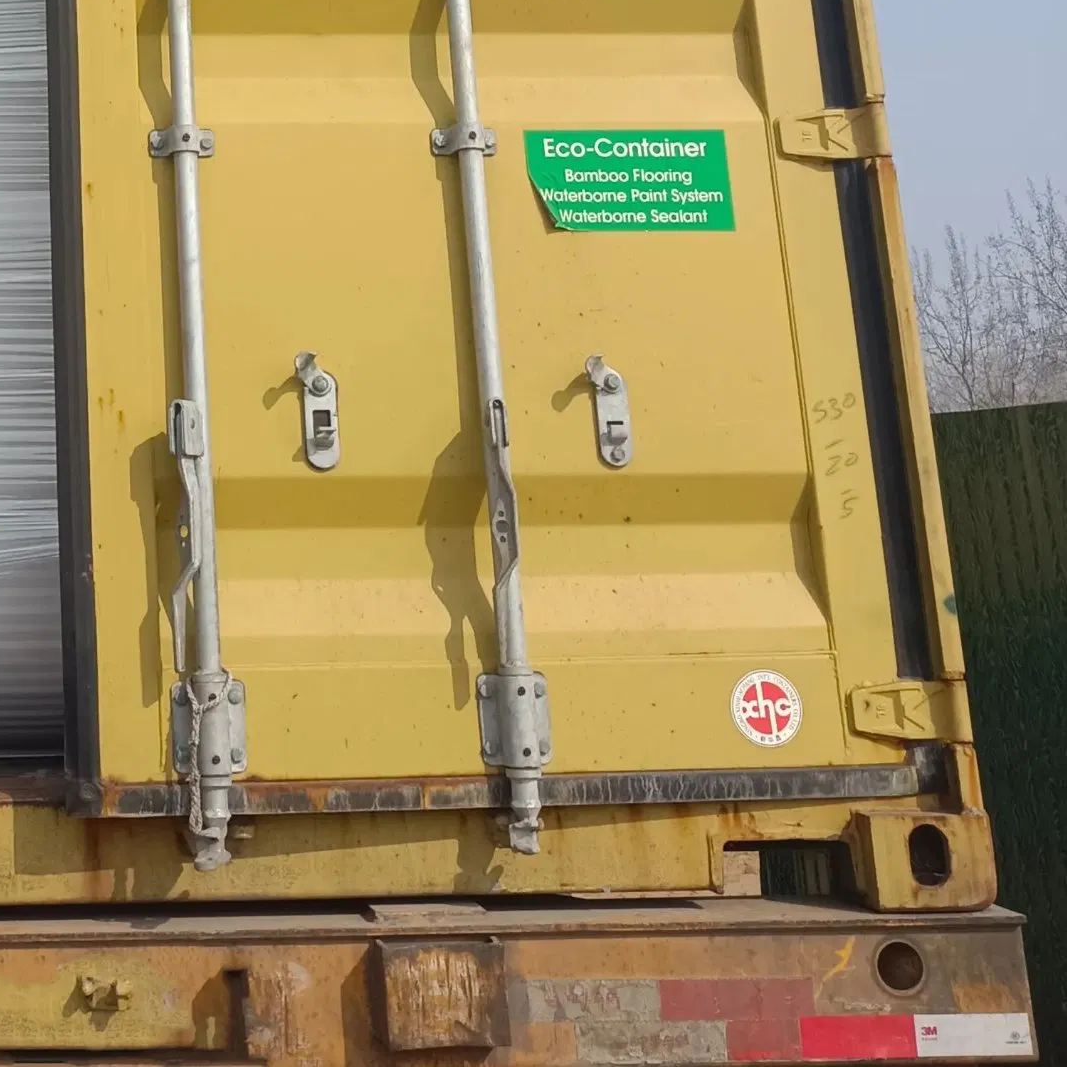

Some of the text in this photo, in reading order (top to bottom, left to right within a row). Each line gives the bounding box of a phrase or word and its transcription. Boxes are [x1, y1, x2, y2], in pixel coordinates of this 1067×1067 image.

[543, 137, 707, 158] Eco-Container
[564, 168, 693, 186] Bamboo Flooring
[540, 188, 724, 205] Waterborne Paint System
[559, 208, 708, 223] Waterborne Sealant
[921, 1026, 938, 1036] 3M
